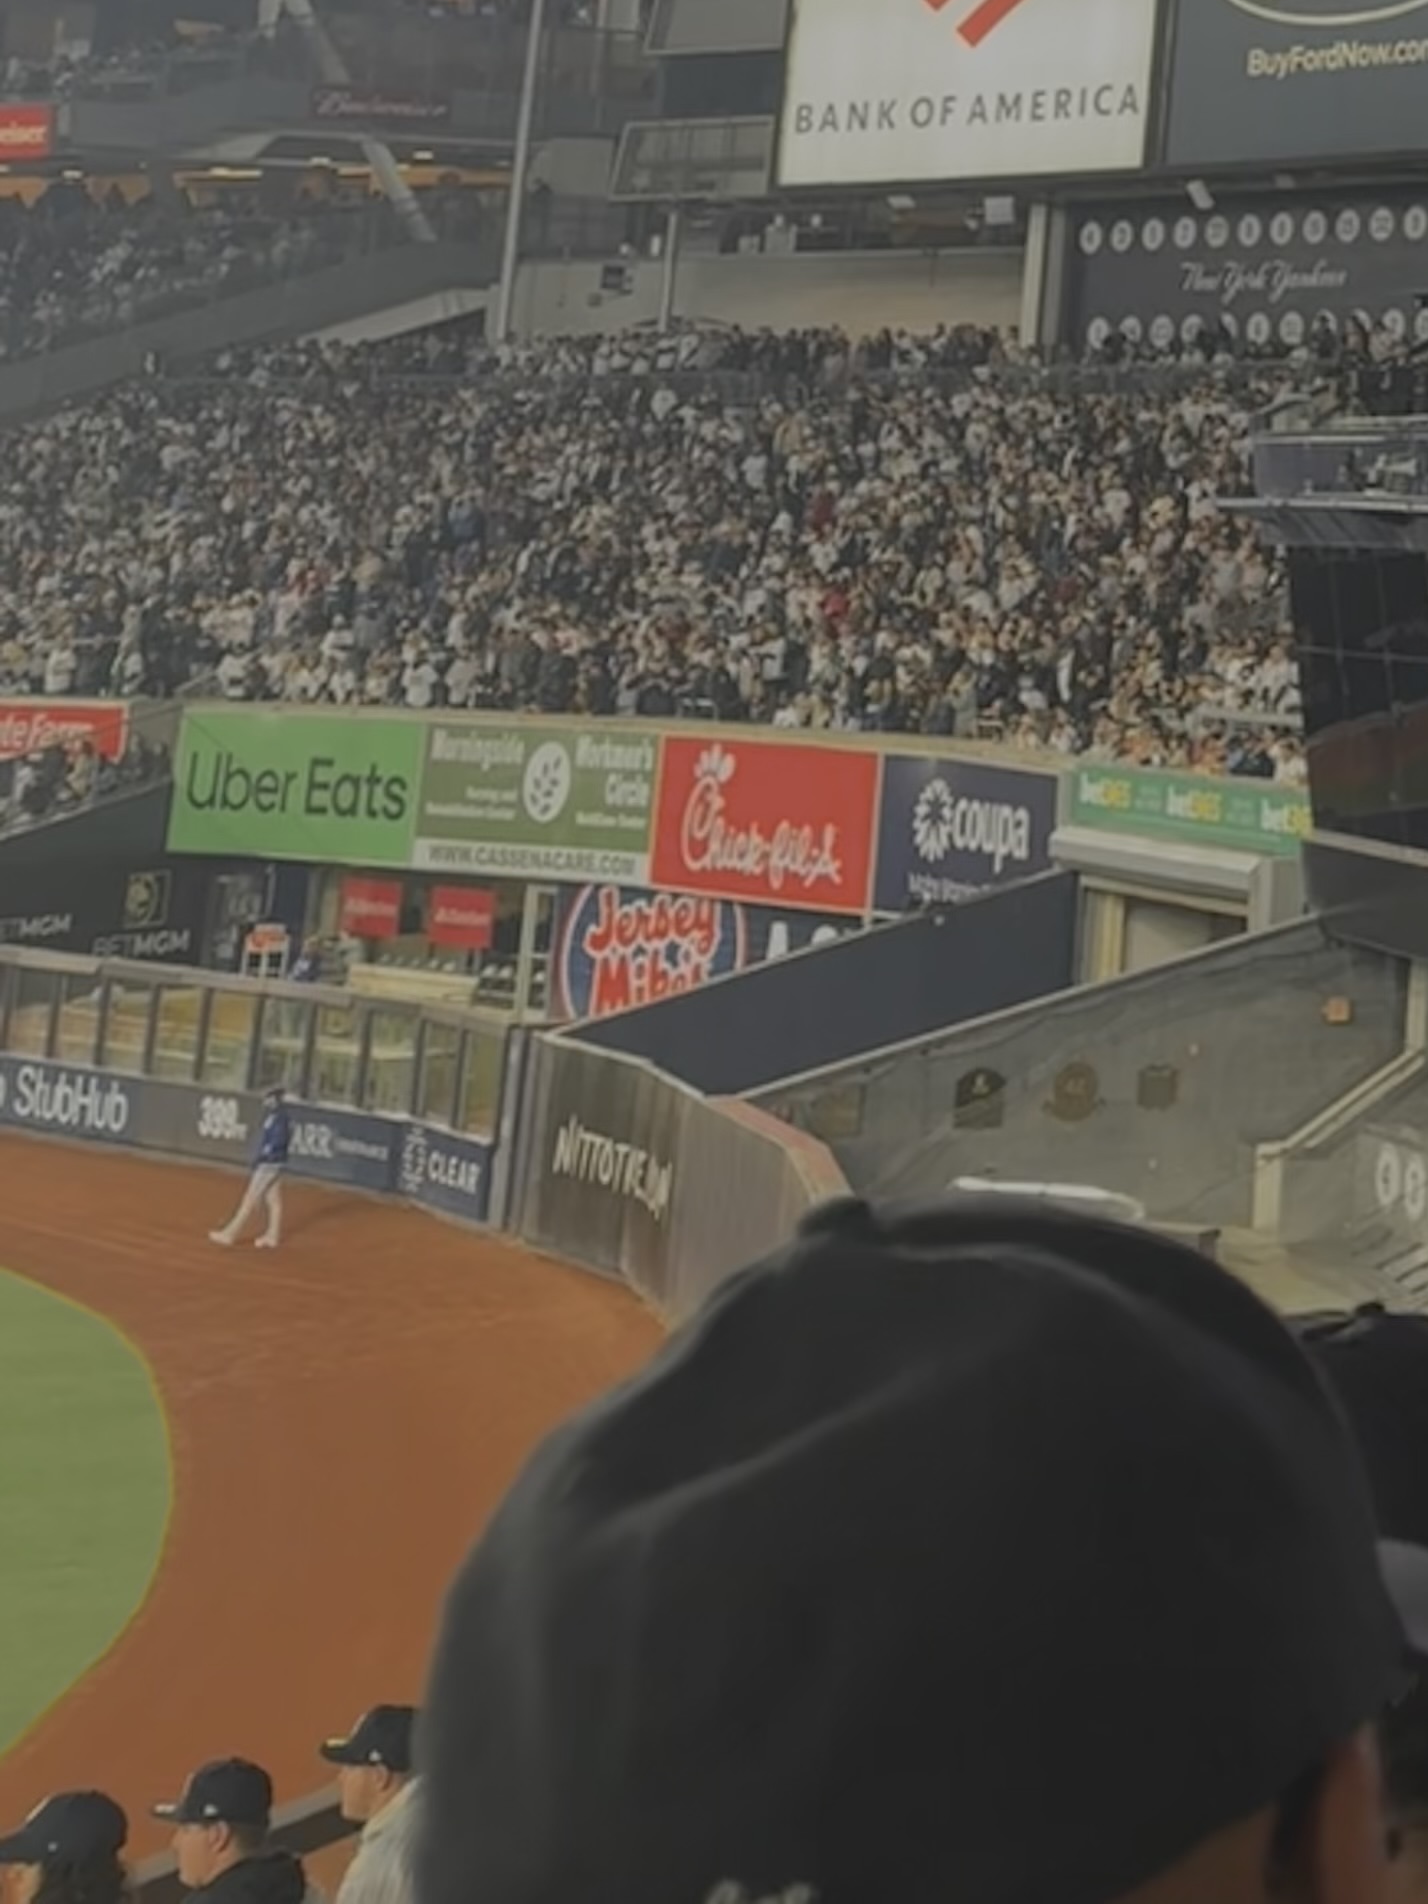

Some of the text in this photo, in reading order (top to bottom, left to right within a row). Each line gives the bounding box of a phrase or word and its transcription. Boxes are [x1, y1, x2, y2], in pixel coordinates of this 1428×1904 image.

[794, 82, 1140, 134] BANK OF AMERICA
[186, 749, 408, 821] Uber Eats
[951, 795, 1030, 874] coupa
[583, 886, 721, 961] Jersey
[14, 1065, 129, 1132] StubHub
[428, 1150, 480, 1195] CLEAR
